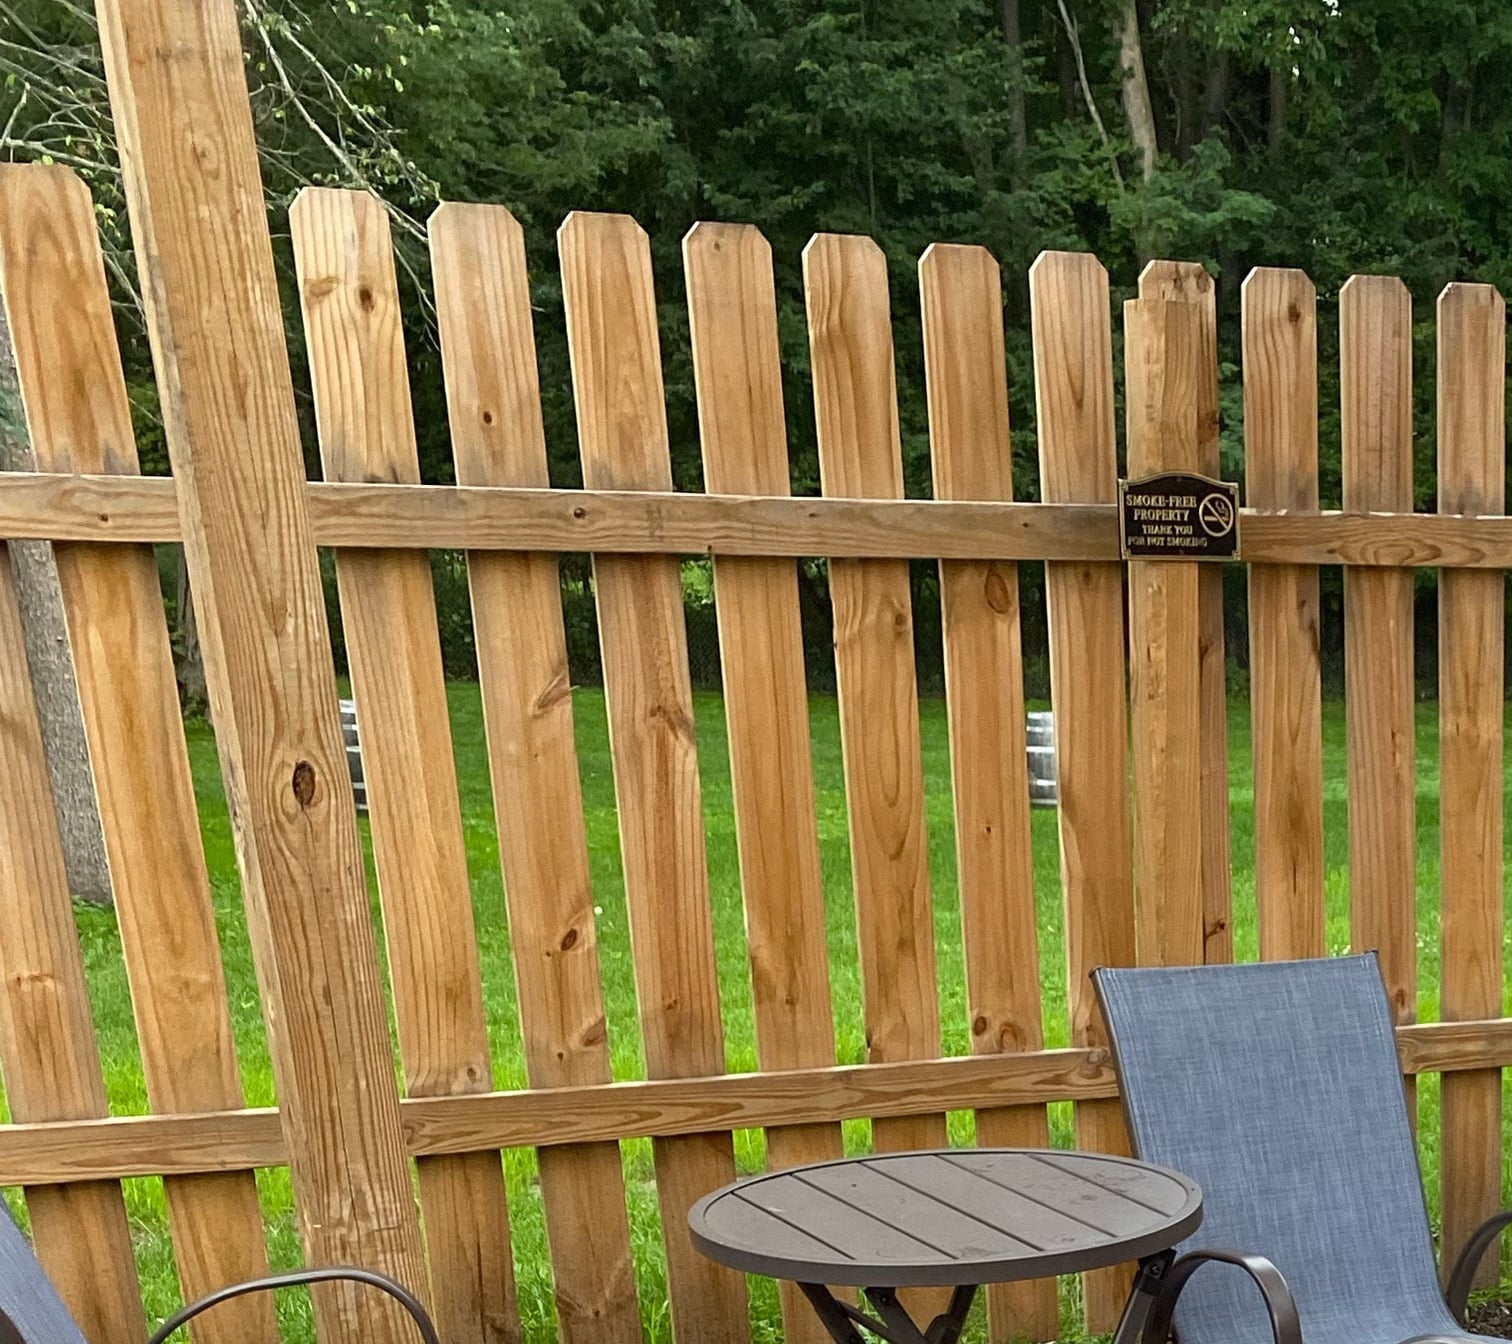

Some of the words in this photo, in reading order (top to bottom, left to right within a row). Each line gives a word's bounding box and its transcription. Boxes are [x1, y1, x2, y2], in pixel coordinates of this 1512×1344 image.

[1126, 494, 1197, 508] SMOKE-FREE
[1133, 508, 1190, 522] PROPERTY
[1141, 524, 1173, 535] THANK
[1174, 524, 1193, 535] YOU
[1127, 535, 1146, 547] FOR
[1147, 536, 1165, 547] NOT
